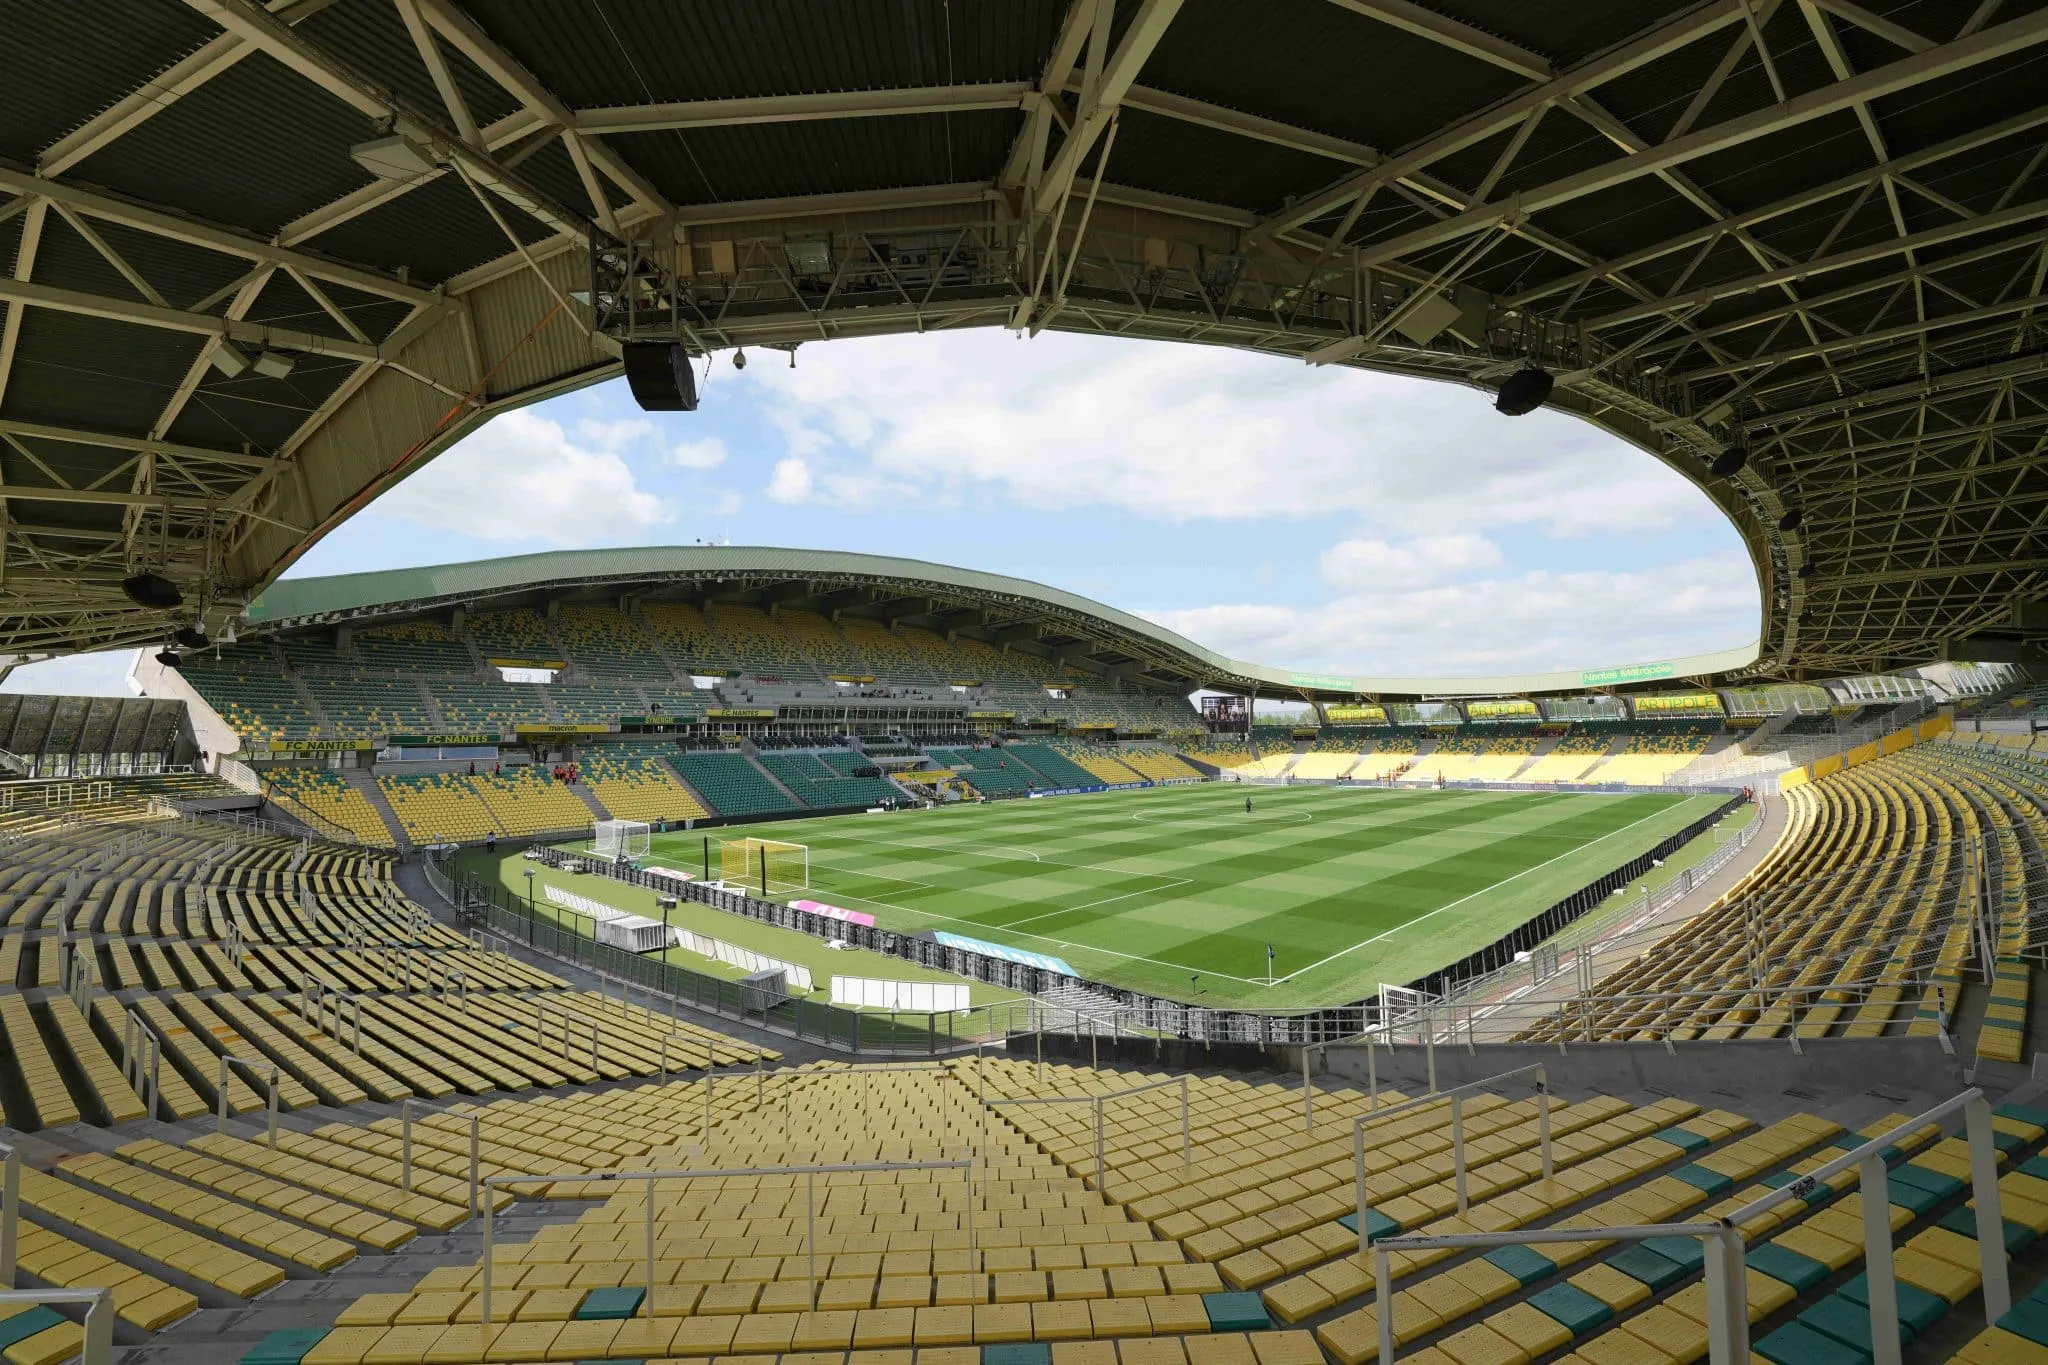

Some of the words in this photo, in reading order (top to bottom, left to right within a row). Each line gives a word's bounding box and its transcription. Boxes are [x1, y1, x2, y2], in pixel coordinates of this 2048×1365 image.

[1584, 671, 1617, 681] Nantes
[1639, 695, 1718, 710] ARTIPOLE
[1470, 704, 1534, 716] ARTIPOLE
[426, 735, 441, 743] FC
[445, 735, 488, 743] NANTES
[286, 742, 303, 750] FC
[306, 741, 356, 750] NANTES
